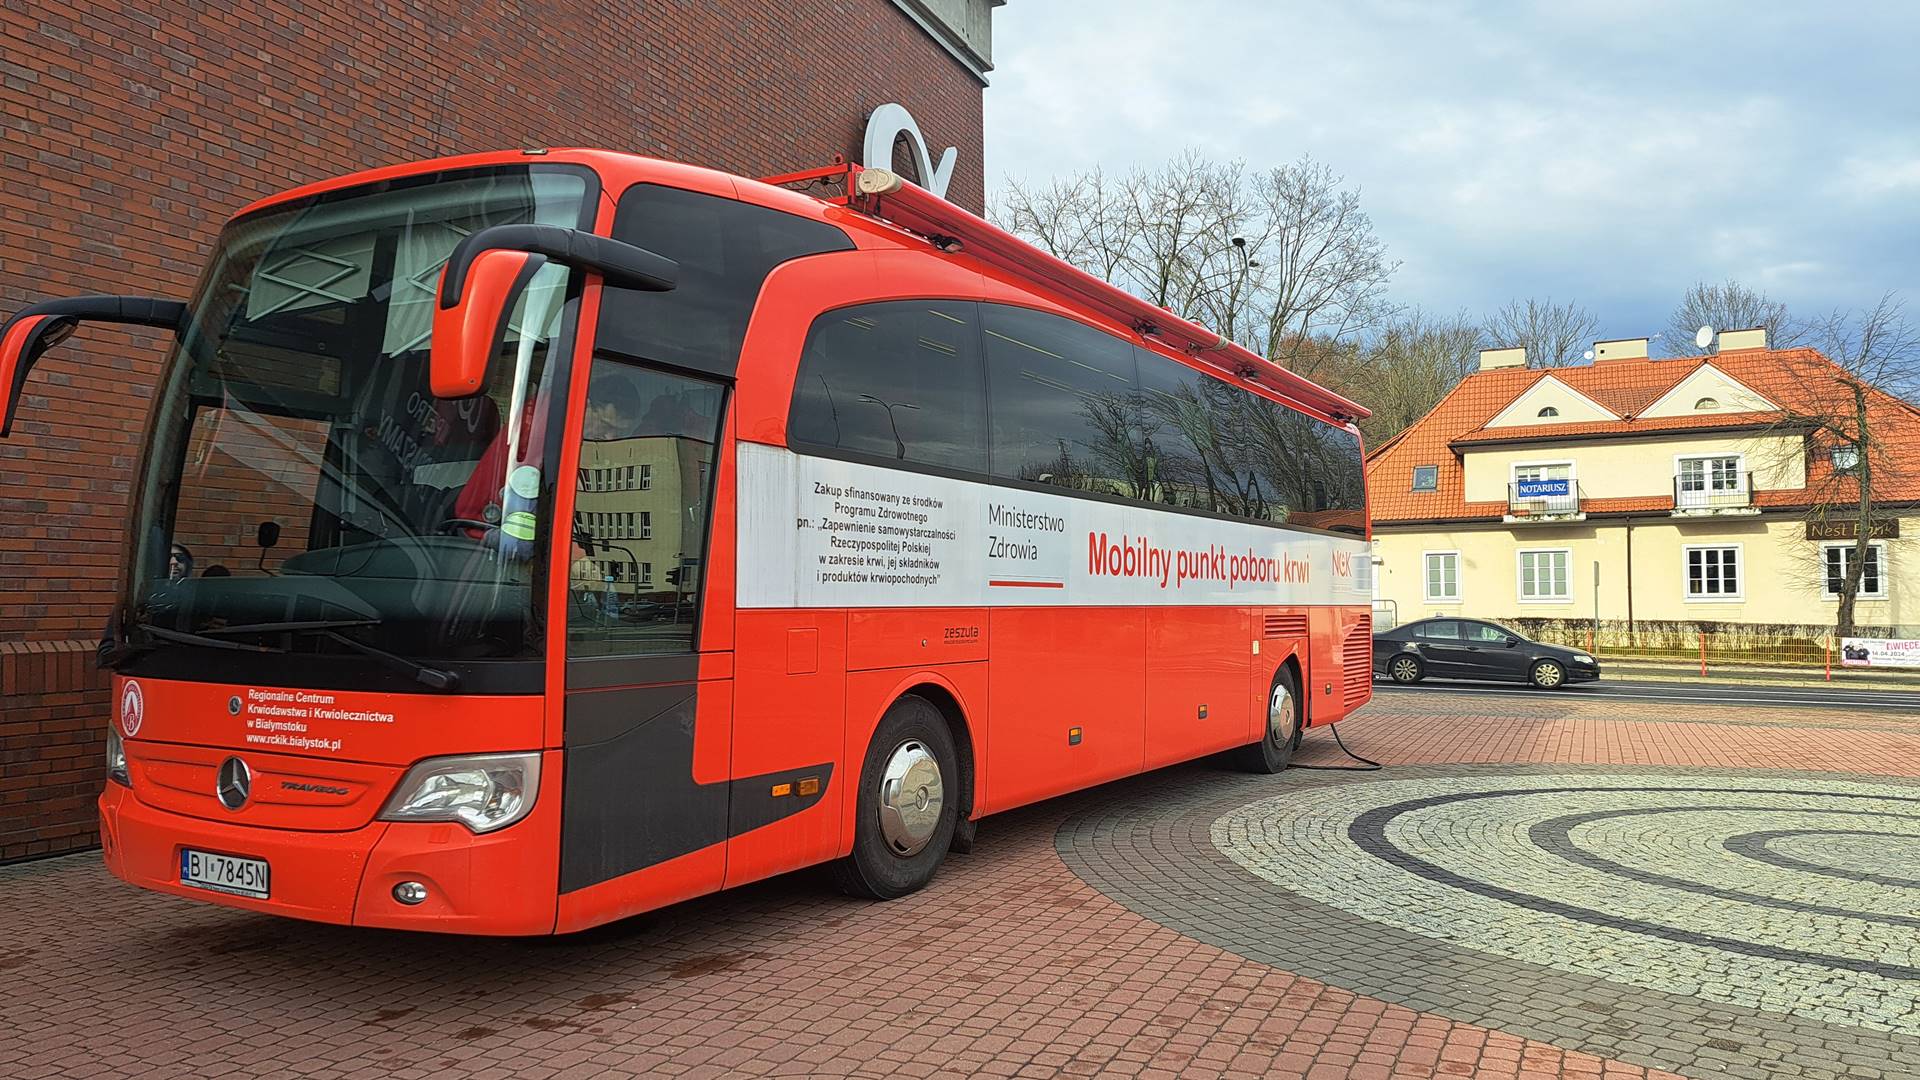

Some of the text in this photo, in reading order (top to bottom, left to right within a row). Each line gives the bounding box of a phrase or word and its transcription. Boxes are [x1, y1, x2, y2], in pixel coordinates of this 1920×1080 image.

[814, 482, 943, 509] Zakup sfinansowany ze środków
[1519, 483, 1567, 494] NOTARIUSZ
[834, 502, 928, 525] Programu Zdrowotnego
[989, 503, 1065, 532] Ministerstwo
[797, 518, 814, 530] pn.:
[878, 525, 956, 540] samowystarczalności
[1811, 524, 1848, 537] Nest
[830, 536, 931, 556] Rzeczypospolitej Polskiej
[988, 536, 1038, 560] Zdrowia
[819, 554, 940, 570] w zakresie krwi, jej składników
[1088, 531, 1310, 590] Mobilny punkt poboru krwi
[822, 571, 868, 584] produktów
[248, 689, 334, 704] Regionalne Centrum
[248, 704, 307, 717] Krwiodawstwa
[314, 708, 394, 722] Krwiolecznictwa
[246, 718, 307, 732] w Białymstoku
[246, 734, 341, 751] www.rckik.bialystok.pl
[190, 853, 265, 888] BI 7845N
